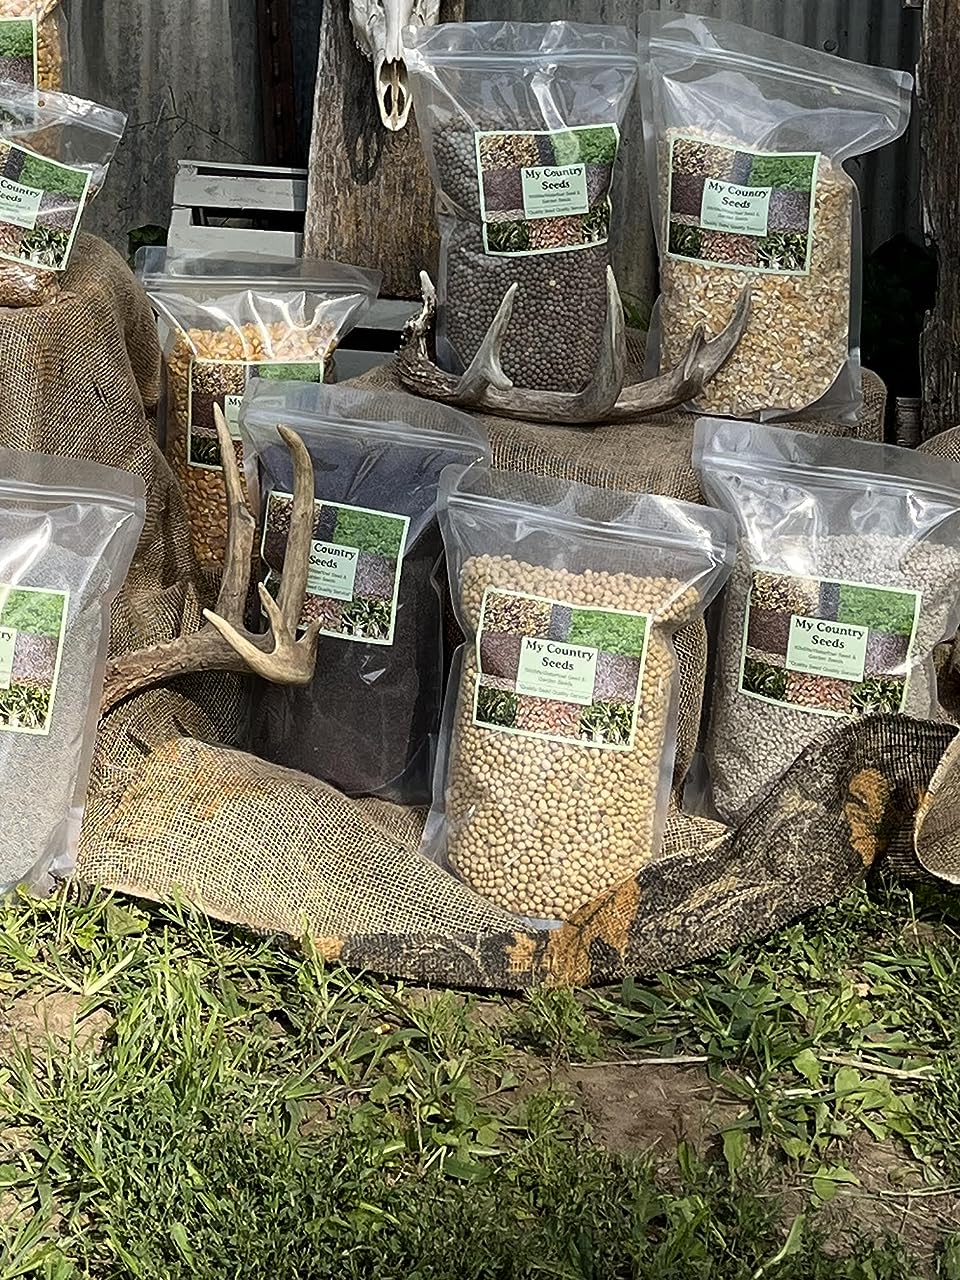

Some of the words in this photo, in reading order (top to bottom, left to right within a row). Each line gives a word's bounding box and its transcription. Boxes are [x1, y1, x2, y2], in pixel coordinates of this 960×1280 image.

[525, 170, 541, 180] My
[543, 168, 583, 177] Country
[0, 180, 40, 198] Country
[542, 180, 570, 190] Seeds
[708, 181, 725, 193] My
[728, 186, 769, 199] Country
[721, 197, 751, 208] Seeds
[314, 543, 356, 560] Country
[309, 555, 338, 569] Seeds
[795, 619, 814, 631] My
[817, 622, 864, 640] Country
[811, 635, 845, 648] Seeds
[526, 640, 544, 653] My
[547, 643, 594, 661] Country
[542, 657, 574, 670] Seeds
